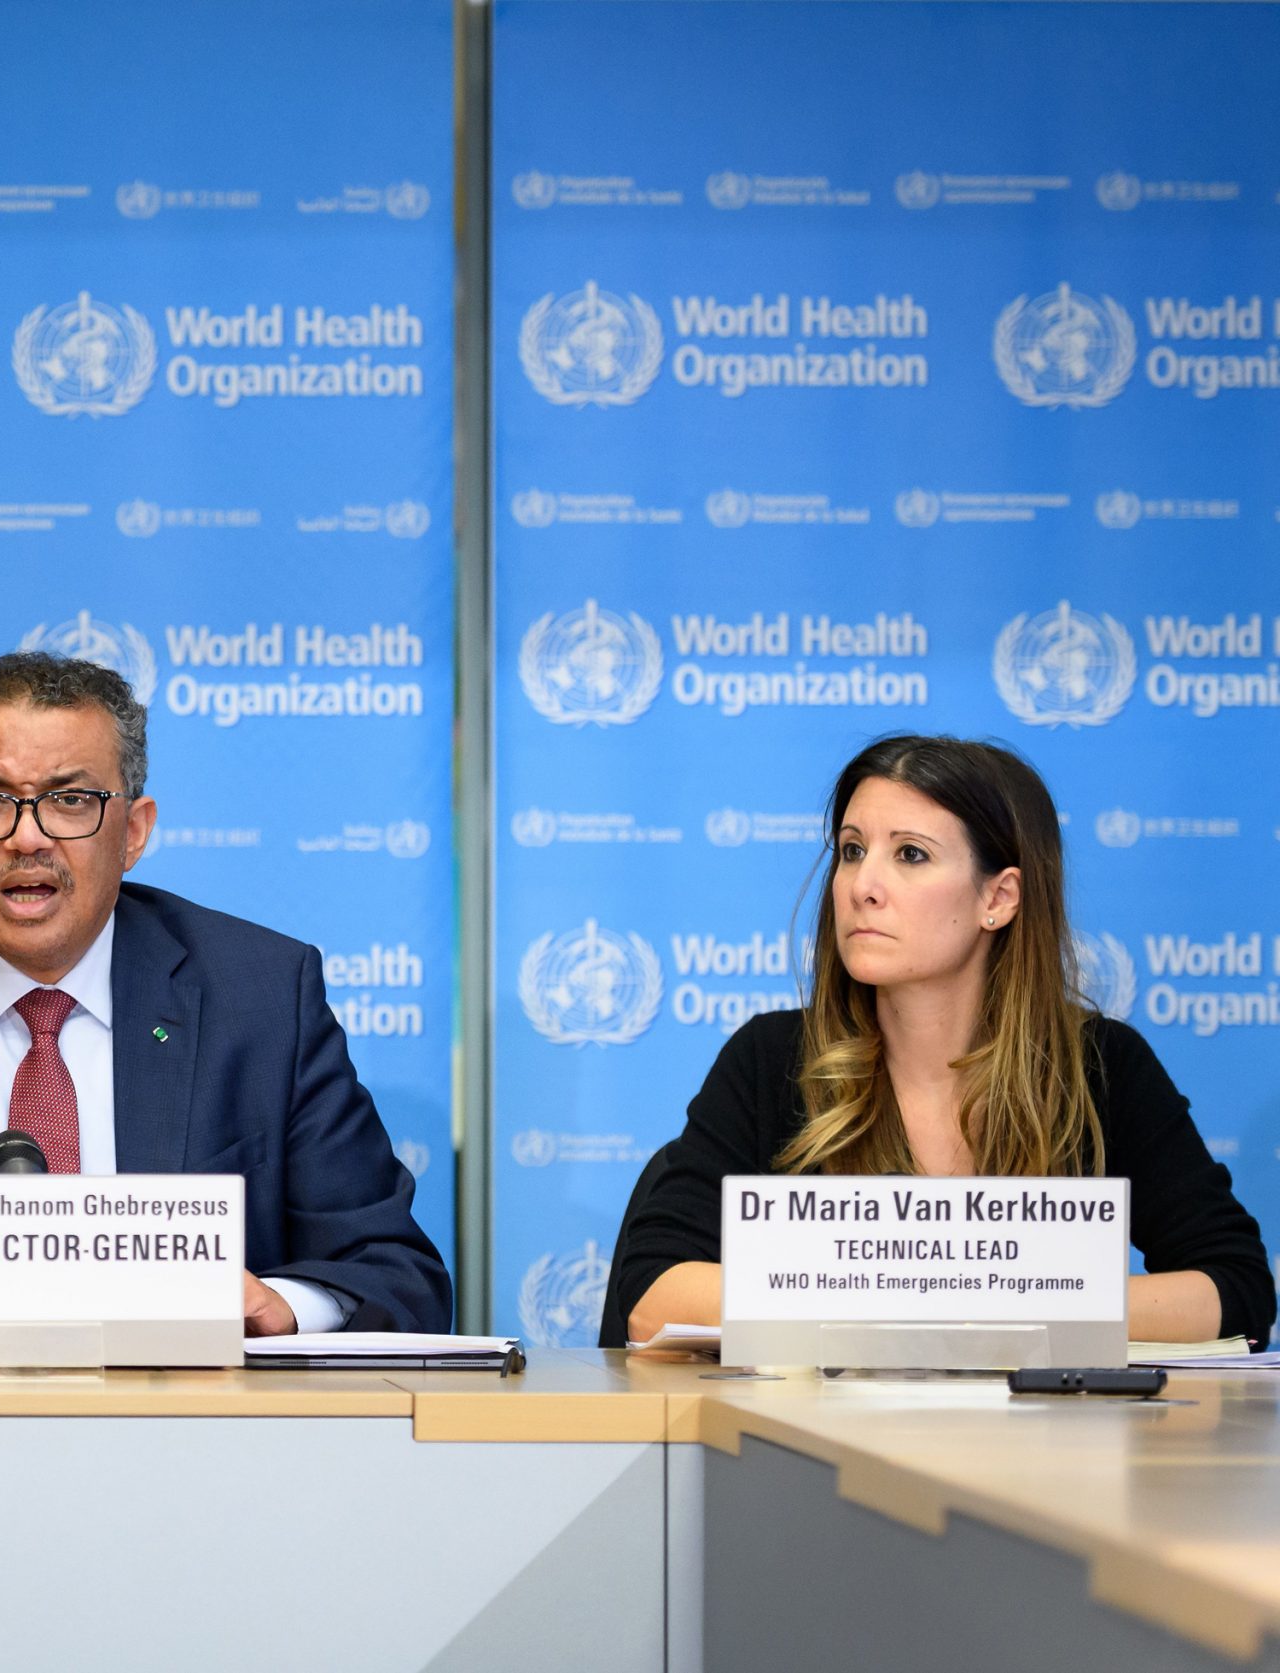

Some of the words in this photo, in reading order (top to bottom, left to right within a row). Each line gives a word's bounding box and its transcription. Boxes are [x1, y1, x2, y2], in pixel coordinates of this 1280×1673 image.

[166, 304, 282, 347] World
[296, 305, 422, 347] Health
[673, 294, 789, 337] World
[801, 295, 927, 337] Health
[1145, 297, 1261, 339] World
[167, 354, 422, 407] Organization
[672, 345, 927, 397] Organization
[166, 624, 283, 666] World
[296, 624, 422, 666] Health
[672, 613, 788, 656] World
[801, 613, 927, 656] Health
[1145, 614, 1261, 657] World
[167, 673, 422, 726] Organization
[672, 663, 927, 716] Organization
[321, 943, 423, 987] ealth
[672, 933, 788, 975] World
[1145, 933, 1261, 976] World
[84, 1194, 228, 1220] Ghebreyesus
[741, 1191, 776, 1221] Dr
[788, 1190, 880, 1222] Maria
[893, 1190, 951, 1222] Van
[965, 1191, 1115, 1223] Kerkhove
[834, 1239, 956, 1260] TECHNICAL
[964, 1240, 1019, 1260] LEAD
[768, 1273, 809, 1289] WHO
[817, 1273, 870, 1290] Health
[877, 1273, 982, 1294] Emergencies
[988, 1273, 1084, 1294] Programme
